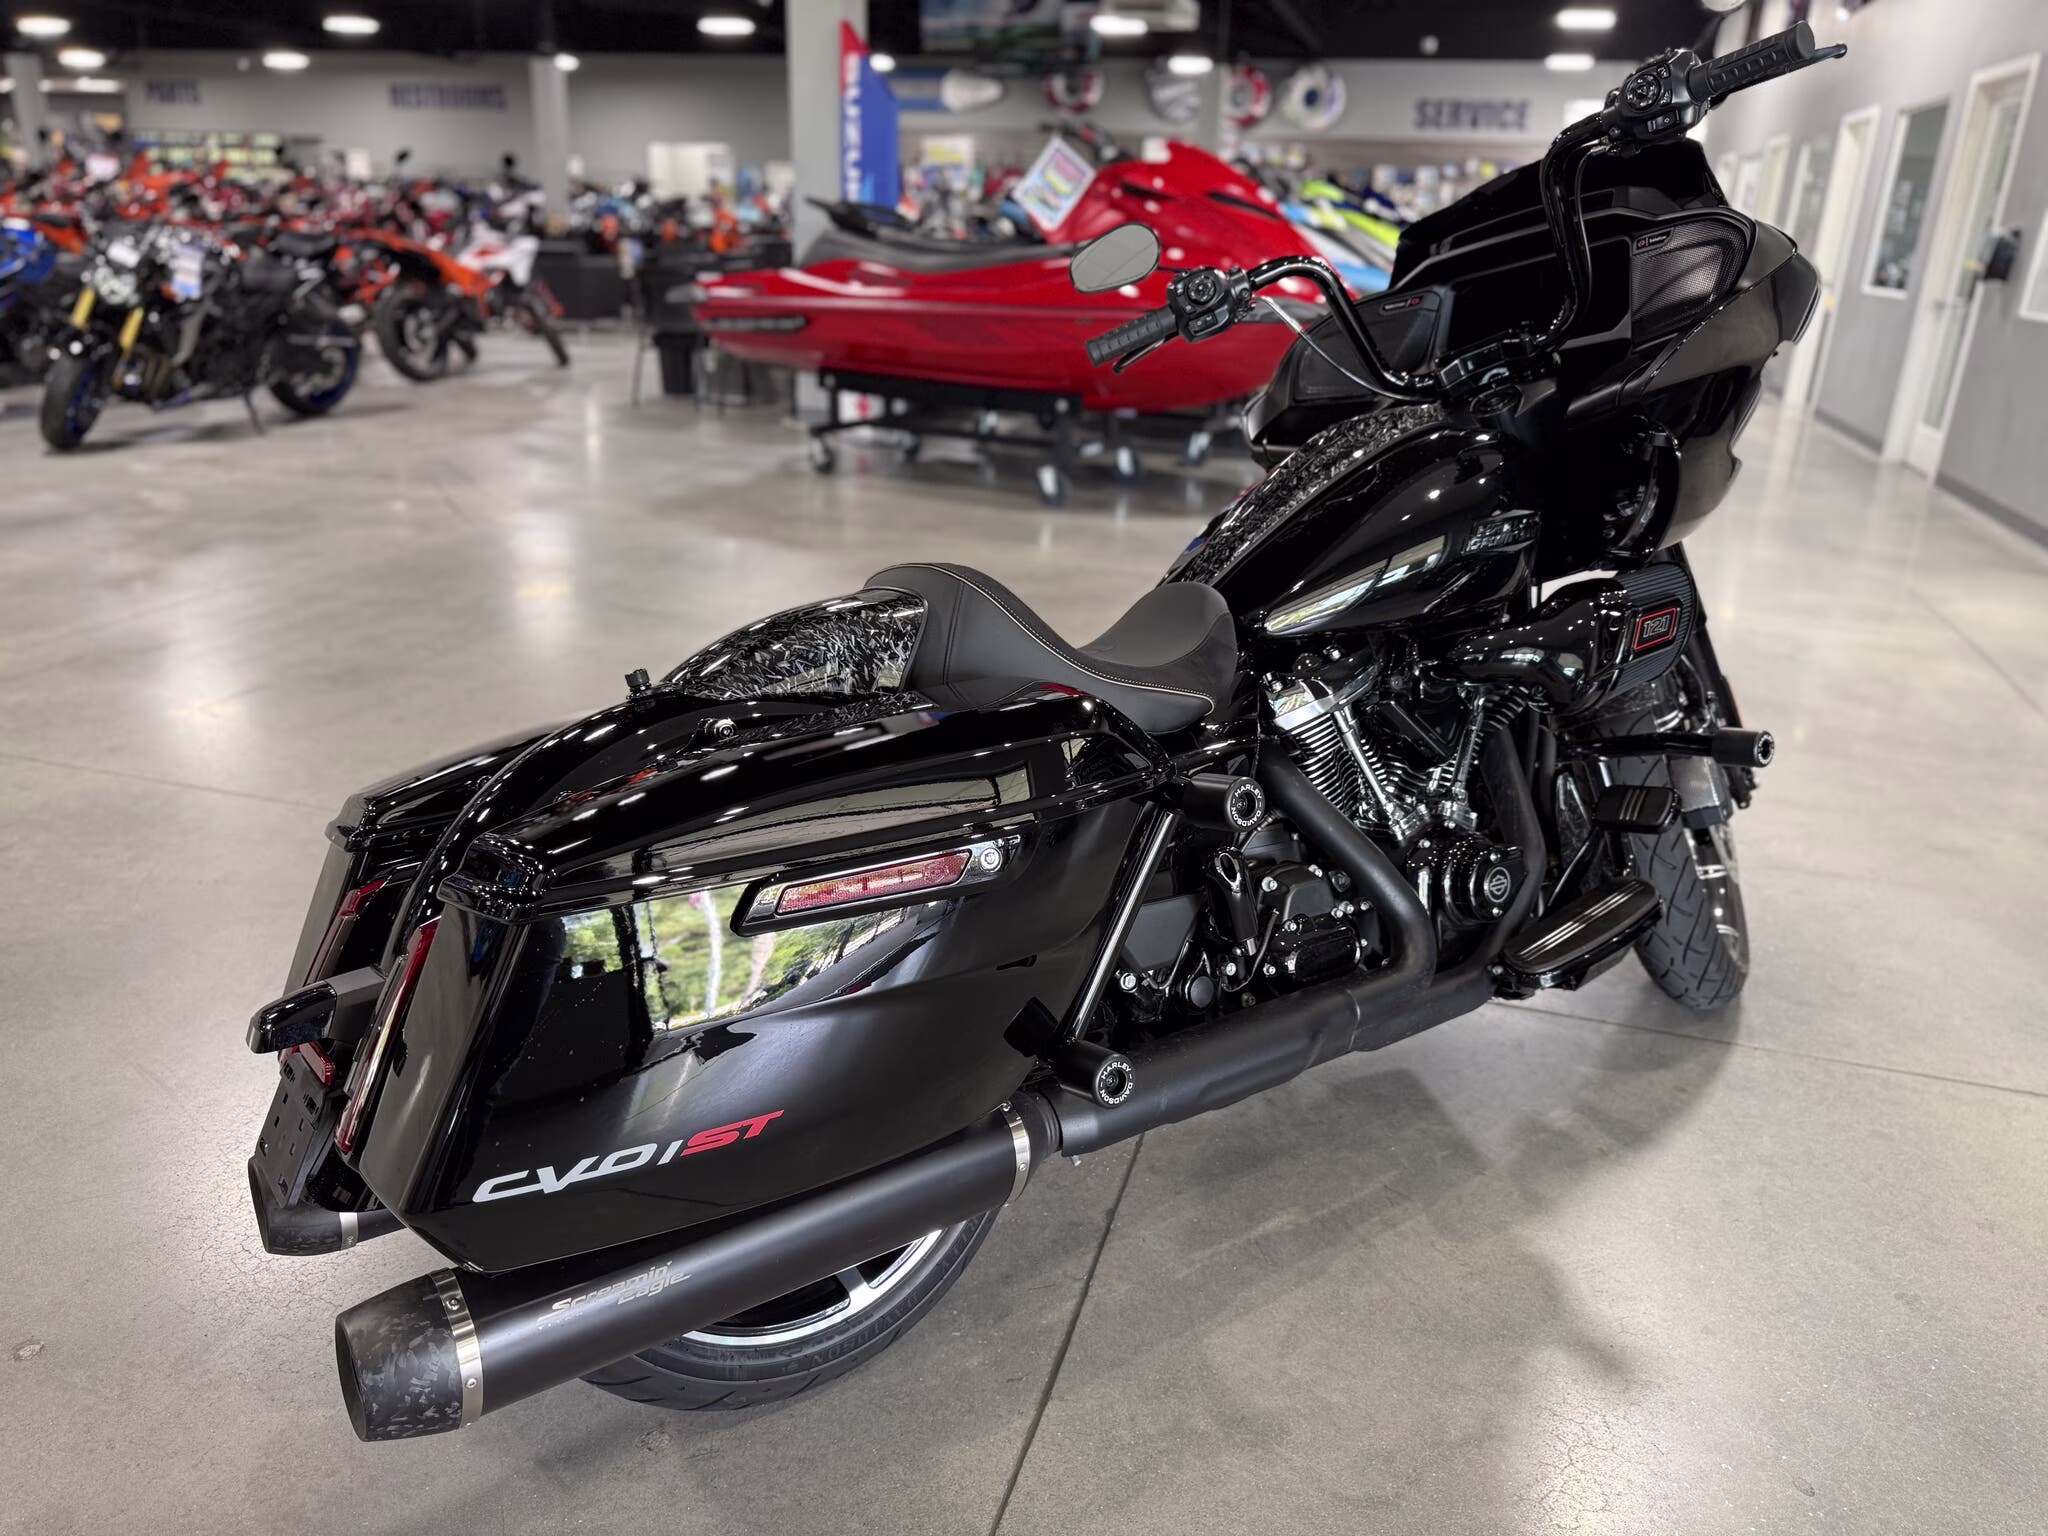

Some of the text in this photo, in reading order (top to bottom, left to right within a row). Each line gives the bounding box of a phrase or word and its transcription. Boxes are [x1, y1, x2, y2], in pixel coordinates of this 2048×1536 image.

[843, 51, 861, 202] SUZUK
[1415, 98, 1528, 132] SERVICE
[1642, 614, 1671, 638] 121
[617, 1272, 692, 1305] Eagle
